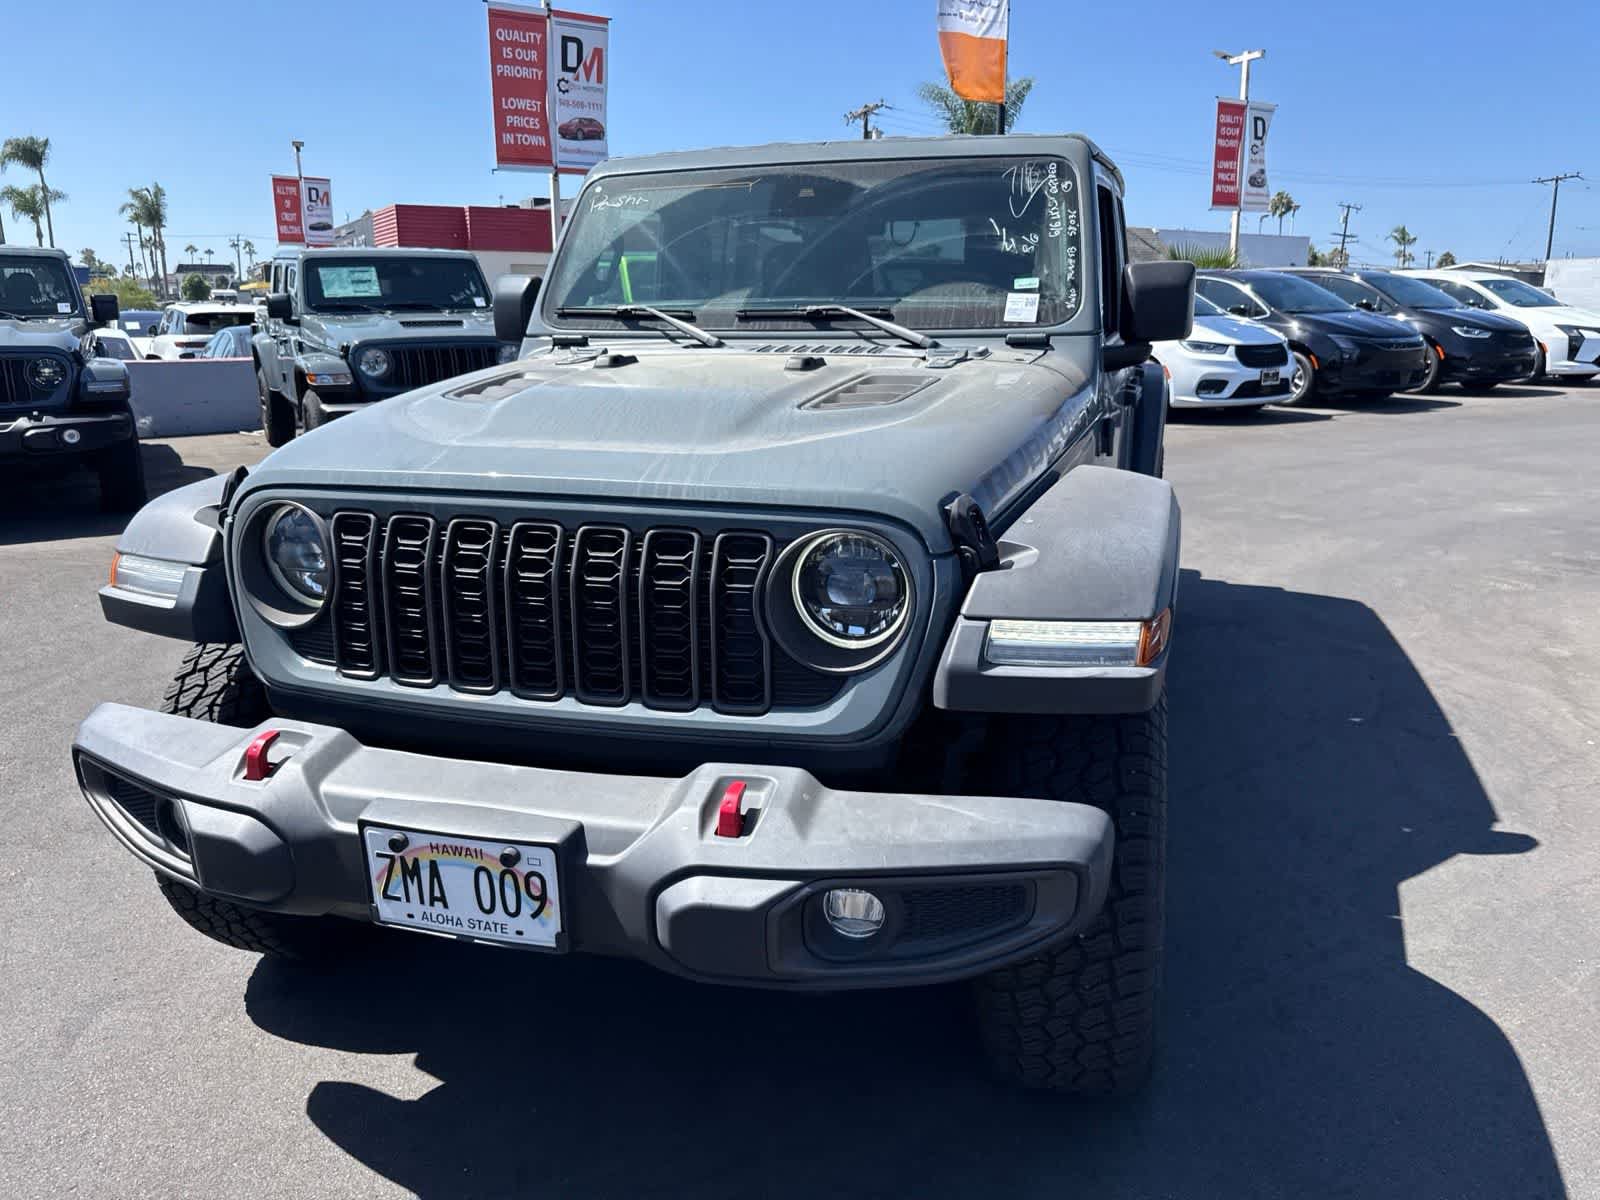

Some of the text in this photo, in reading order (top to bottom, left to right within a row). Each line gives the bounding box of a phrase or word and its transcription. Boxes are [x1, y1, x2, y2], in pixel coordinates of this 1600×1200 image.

[496, 28, 542, 44] QUALITY
[502, 47, 538, 62] IS OUR
[496, 65, 543, 80] PRIORITY
[502, 97, 542, 112] LOWEST
[506, 115, 540, 129] PRICES
[1219, 114, 1243, 125] QUALITY
[503, 133, 546, 146] IN TOWN
[429, 842, 484, 860] HAWAII
[376, 852, 547, 920] ZMA 009
[421, 911, 509, 935] ALOHA STATE
